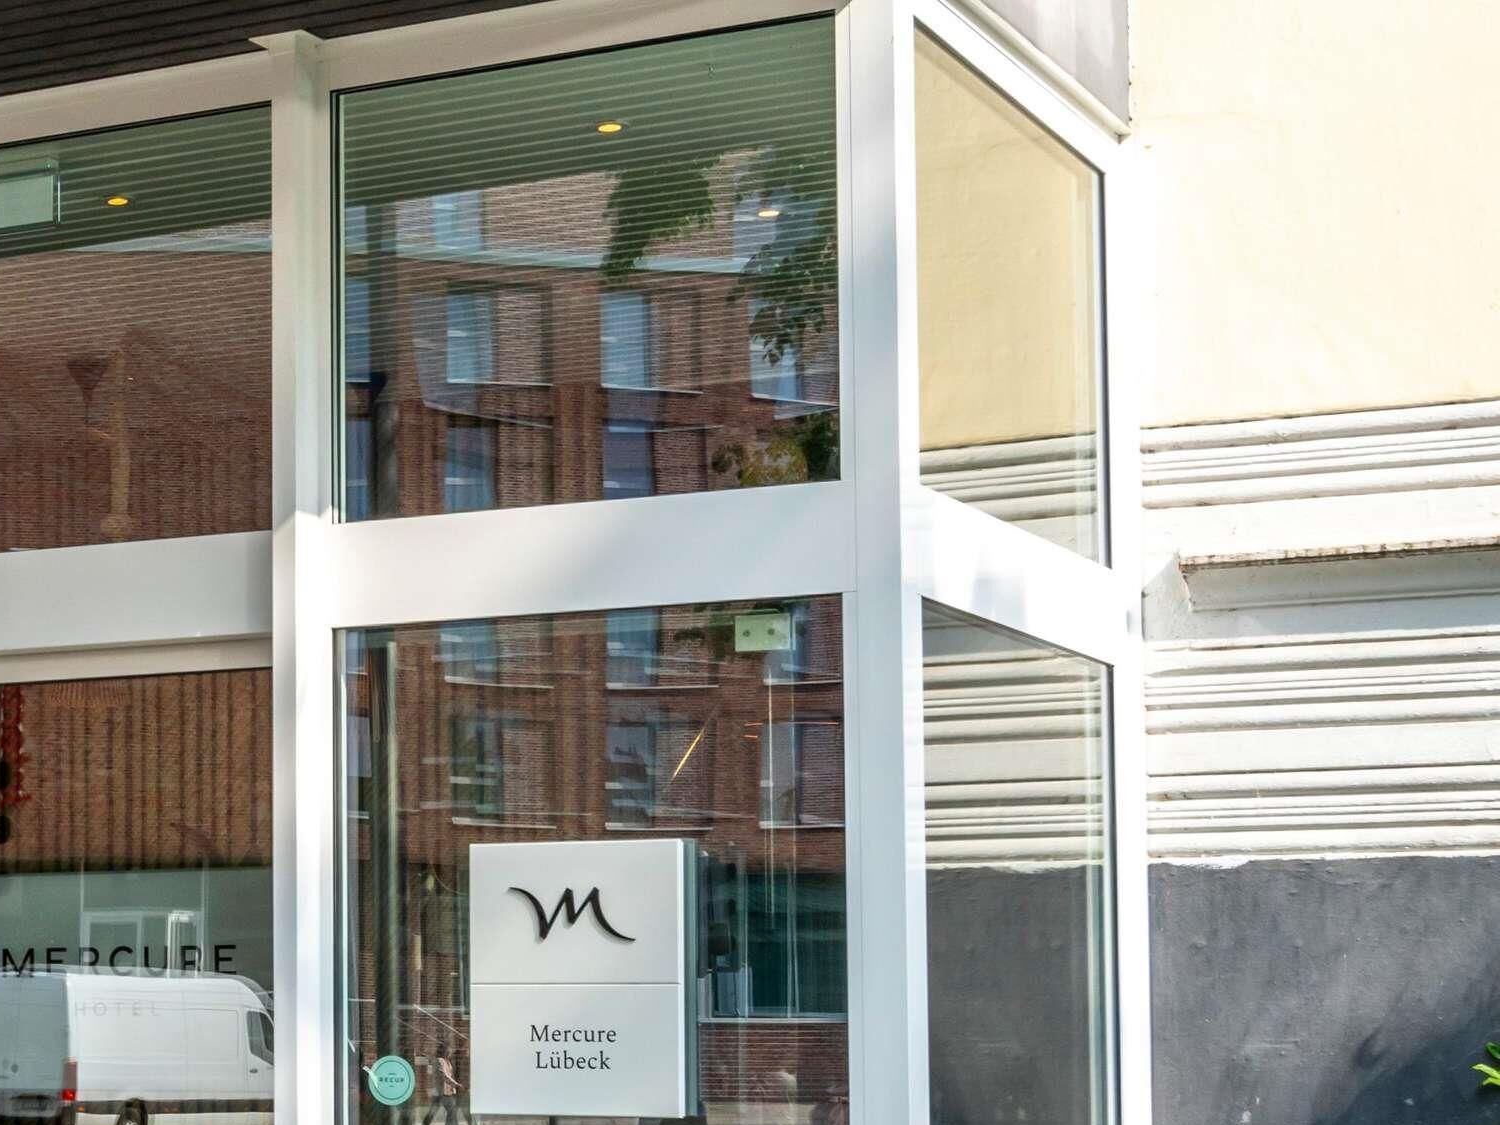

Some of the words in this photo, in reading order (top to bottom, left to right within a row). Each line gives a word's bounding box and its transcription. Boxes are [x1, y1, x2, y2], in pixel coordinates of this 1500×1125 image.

[1, 944, 237, 978] MERCURE
[74, 1000, 161, 1017] HOTEL
[529, 1024, 618, 1043] Mercure
[535, 1050, 611, 1070] Lübeck
